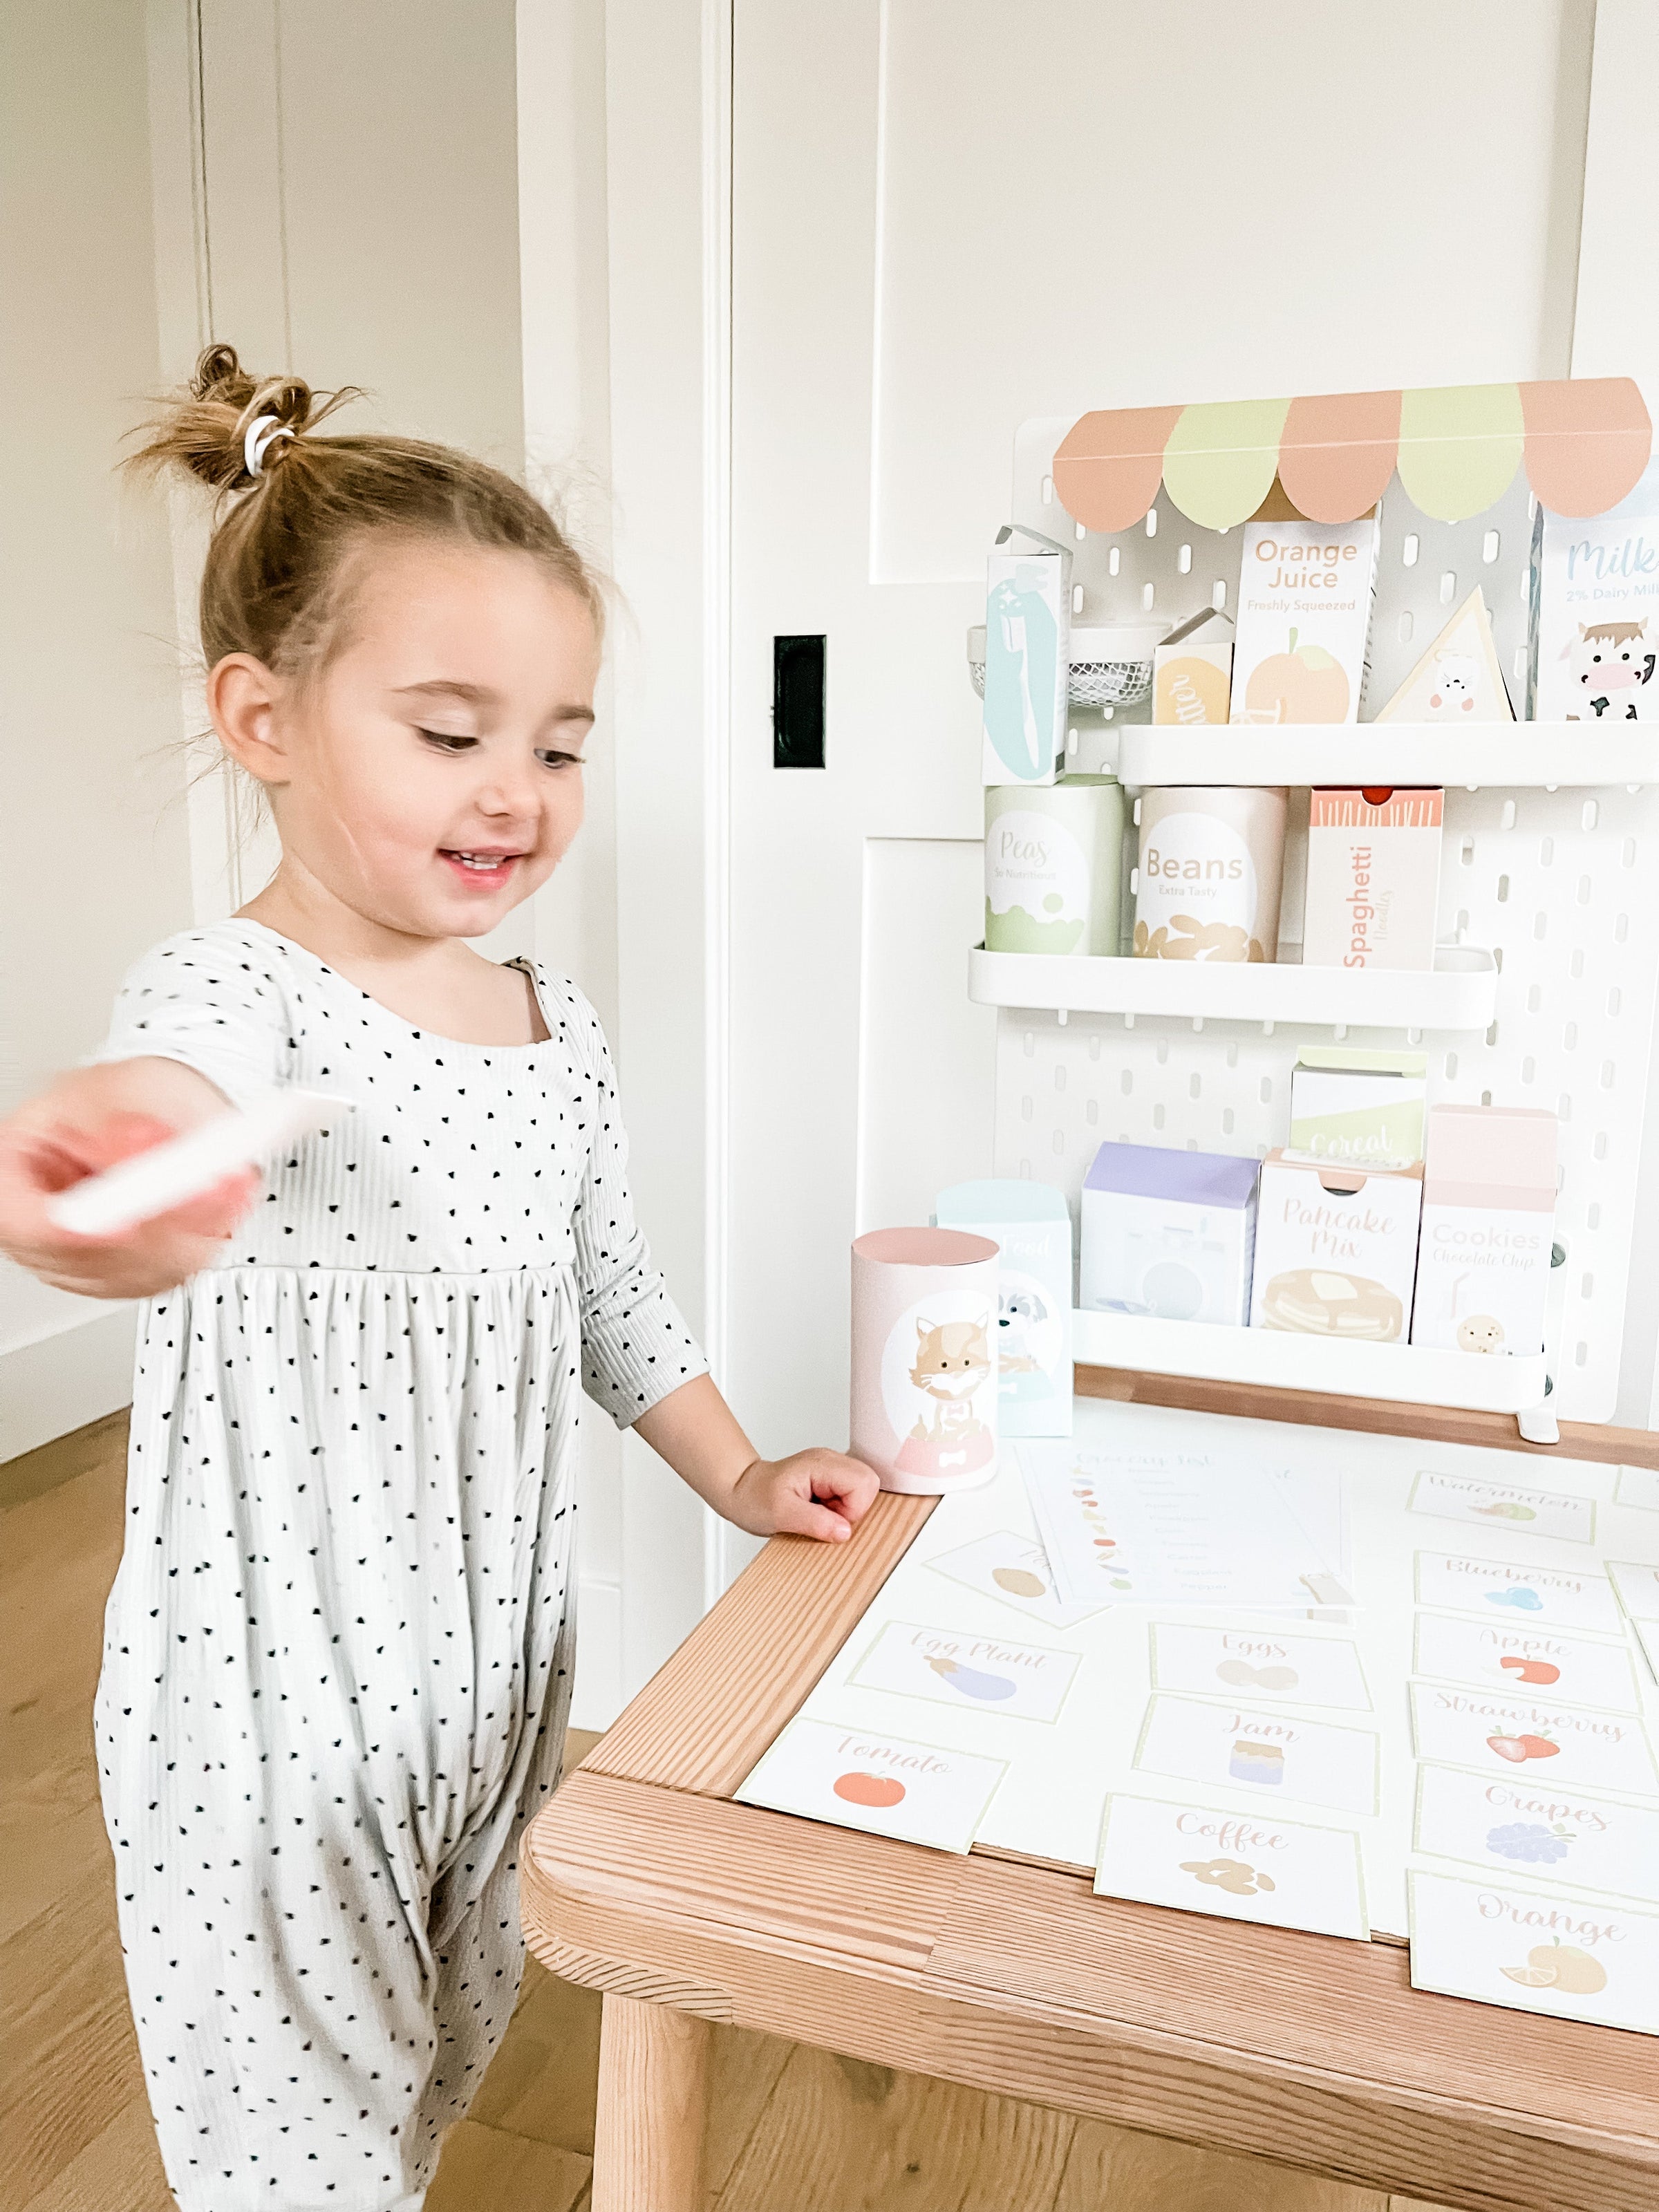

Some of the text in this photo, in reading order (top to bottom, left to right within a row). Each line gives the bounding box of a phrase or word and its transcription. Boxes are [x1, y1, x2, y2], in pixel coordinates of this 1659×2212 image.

[1256, 540, 1358, 568] Orange
[1567, 537, 1659, 580] Milk
[1268, 566, 1338, 588] Juice
[1247, 599, 1356, 613] Freshly Squeezed
[1566, 590, 1588, 601] 2%
[1593, 587, 1629, 601] Dairy
[1001, 830, 1051, 868] Peas
[1147, 847, 1243, 880] Beans
[1159, 885, 1217, 899] Extra Tasty
[1342, 845, 1375, 968] Spaghetti
[1310, 1124, 1394, 1157] Cereal
[1282, 1197, 1397, 1235] Pancake
[1310, 1228, 1363, 1259] Mix
[1432, 1224, 1541, 1250] Cookies
[1433, 1247, 1499, 1266] Chocolate
[1445, 1559, 1585, 1594] Blueberry
[910, 1631, 1048, 1669] Egg Plant
[1221, 1634, 1291, 1658] Eggs
[1479, 1629, 1573, 1656] Apple
[1221, 1714, 1300, 1743] Jam
[1433, 1692, 1627, 1743] Strawberry
[836, 1734, 953, 1774] Tomato
[1485, 1785, 1613, 1833] Grapes
[1176, 1812, 1289, 1853] Coffee
[1477, 1893, 1627, 1947] Orange
